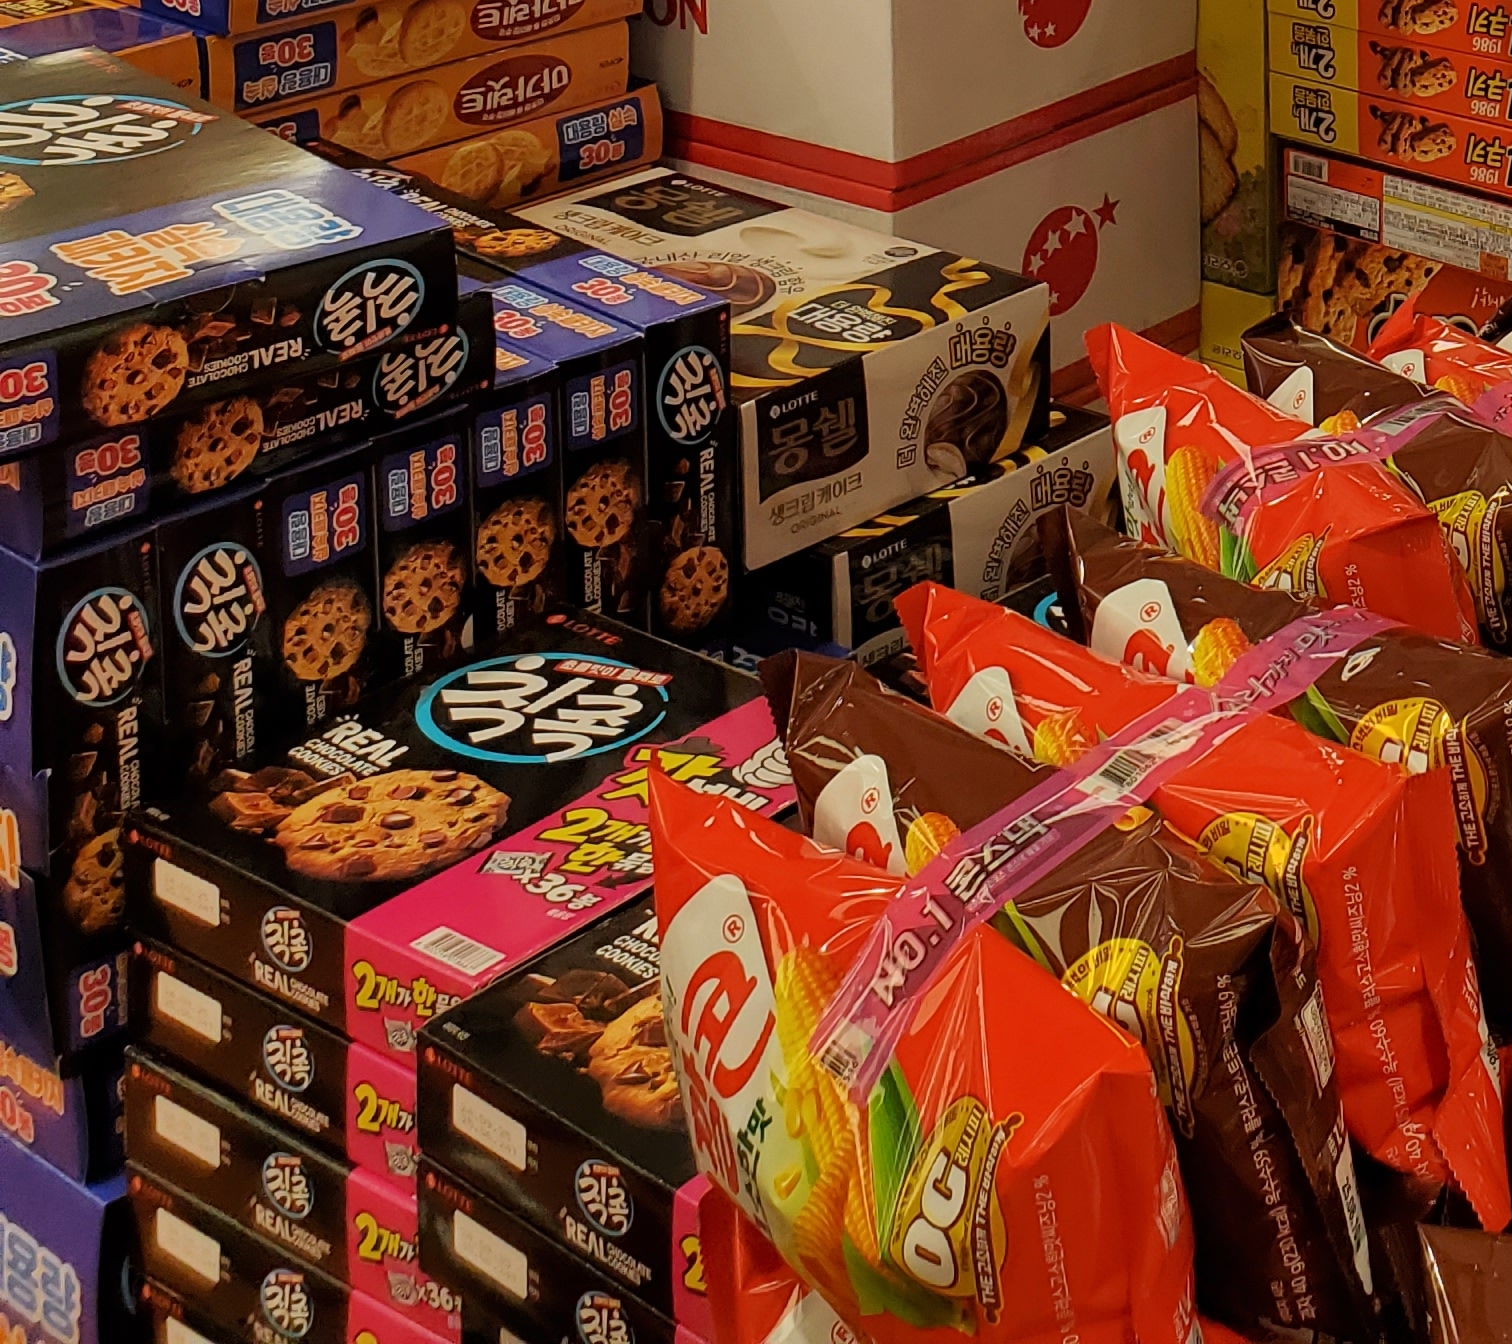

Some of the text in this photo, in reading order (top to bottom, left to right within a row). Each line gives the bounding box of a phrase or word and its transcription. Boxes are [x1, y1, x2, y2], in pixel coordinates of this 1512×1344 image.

[1472, 37, 1502, 53] 1986
[460, 67, 570, 114] 마가렛트
[579, 139, 625, 168] 30봉
[1469, 167, 1501, 183] 1986
[250, 337, 303, 370] REAL
[948, 322, 1018, 370] 대용량
[317, 399, 363, 431] REAL
[779, 389, 820, 416] LOTTE
[771, 399, 856, 475] 몽쉘
[700, 446, 716, 493] REAL
[769, 473, 864, 526] 생크림케이크
[873, 538, 908, 566] LOTTE
[235, 655, 255, 713] REAL
[440, 656, 644, 763] 칙촉
[117, 705, 139, 762] REAL
[323, 721, 409, 768] REAL
[287, 745, 343, 778] COOKIES
[304, 738, 380, 778] CHOCOLATE
[595, 944, 659, 979] COOKIES
